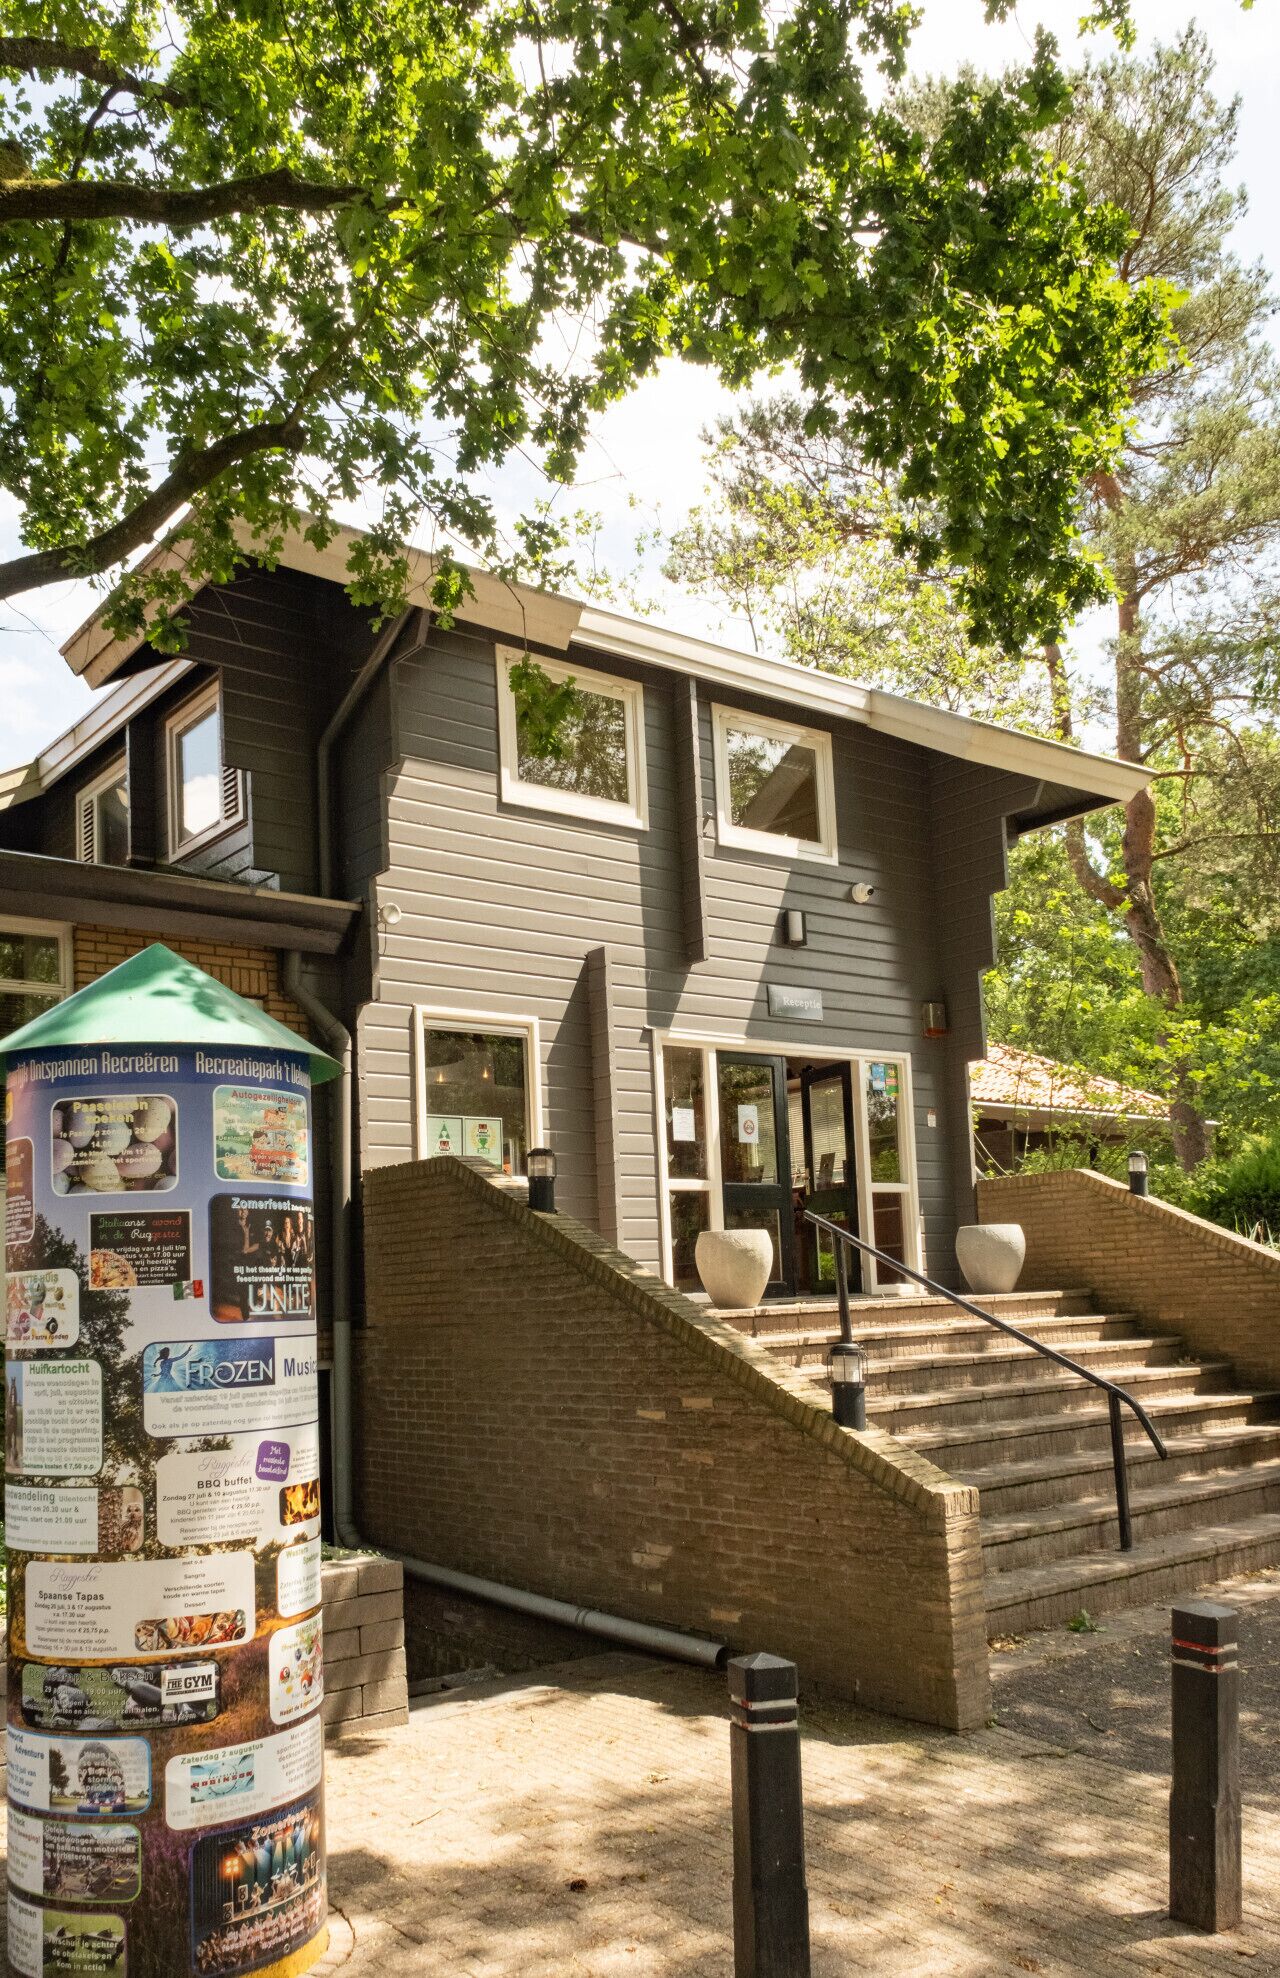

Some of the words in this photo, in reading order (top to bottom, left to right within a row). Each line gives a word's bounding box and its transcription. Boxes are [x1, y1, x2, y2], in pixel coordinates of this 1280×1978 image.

[784, 996, 822, 1010] Receptie
[30, 1060, 98, 1083] Ontspannen
[102, 1052, 178, 1074] Recreëren
[195, 1051, 283, 1083] Recreatiepark
[231, 1197, 291, 1212] Zomerfeest
[116, 1246, 140, 1254] vrijdag
[248, 1284, 310, 1313] UNITE
[29, 1363, 90, 1375] Huifkartocht
[185, 1357, 273, 1389] FROZEN
[202, 1418, 232, 1427] zaterdag
[197, 1480, 221, 1490] BBQ
[224, 1477, 252, 1487] buffet
[183, 1572, 206, 1580] Sangria
[164, 1584, 202, 1592] Verschillende
[191, 1589, 210, 1597] warme
[38, 1590, 73, 1601] Spaanse
[75, 1592, 105, 1602] Tapas
[84, 1604, 112, 1612] augustus
[184, 1601, 206, 1609] Dessert
[100, 1670, 154, 1683] Boksen
[166, 1679, 182, 1691] THE
[183, 1673, 213, 1689] GYM
[14, 1743, 45, 1760] Adventure
[181, 1752, 219, 1765] Zaterdag
[222, 1750, 228, 1758] 2
[229, 1742, 264, 1757] augustus
[91, 1941, 118, 1949] achter
[73, 1963, 81, 1971] in
